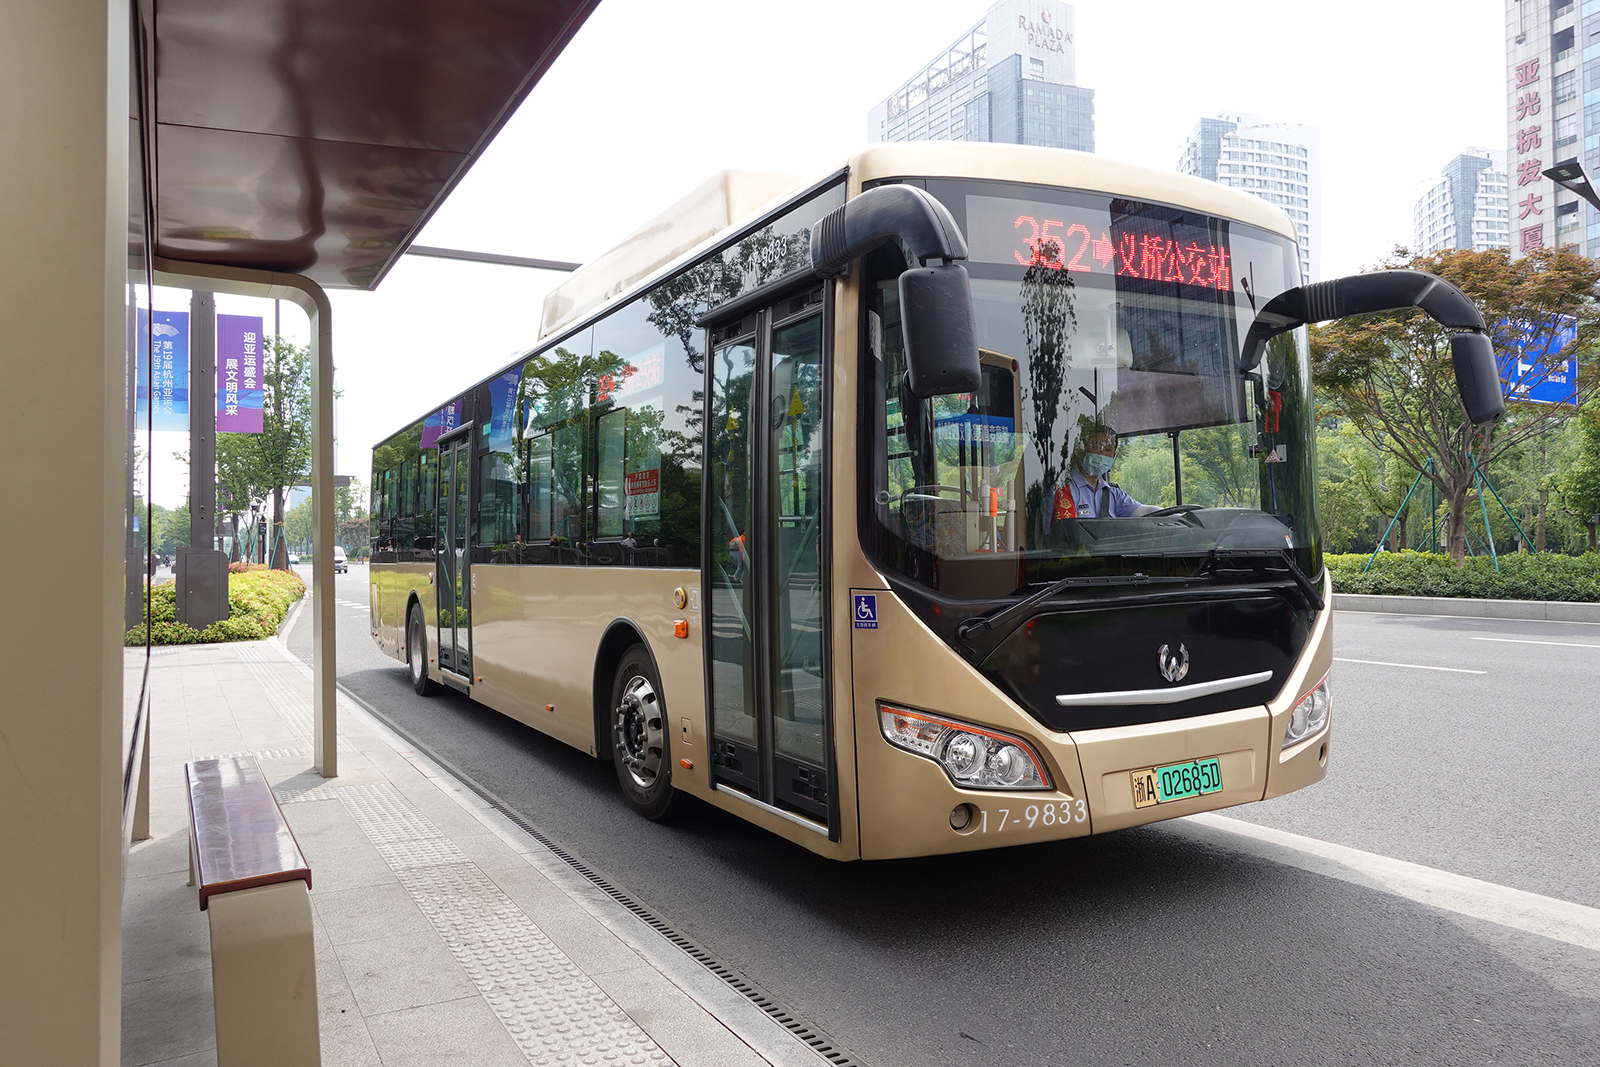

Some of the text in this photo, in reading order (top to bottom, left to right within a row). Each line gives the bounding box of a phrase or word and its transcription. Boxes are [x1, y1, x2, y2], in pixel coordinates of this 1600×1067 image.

[1018, 14, 1072, 44] RAMADA
[1027, 33, 1064, 54] PLAZA
[1516, 57, 1544, 252] 亚光杭发大厦
[1014, 215, 1091, 272] 352
[1117, 231, 1230, 291] 义桥公交站
[153, 340, 161, 415] The 19th Asian Games
[163, 341, 173, 415] 第19届杭州亚运会
[225, 358, 239, 416] 展文明风采
[243, 331, 256, 389] 迎亚运盛会
[1162, 762, 1221, 797] 02685D
[981, 799, 1087, 834] 17-9833
